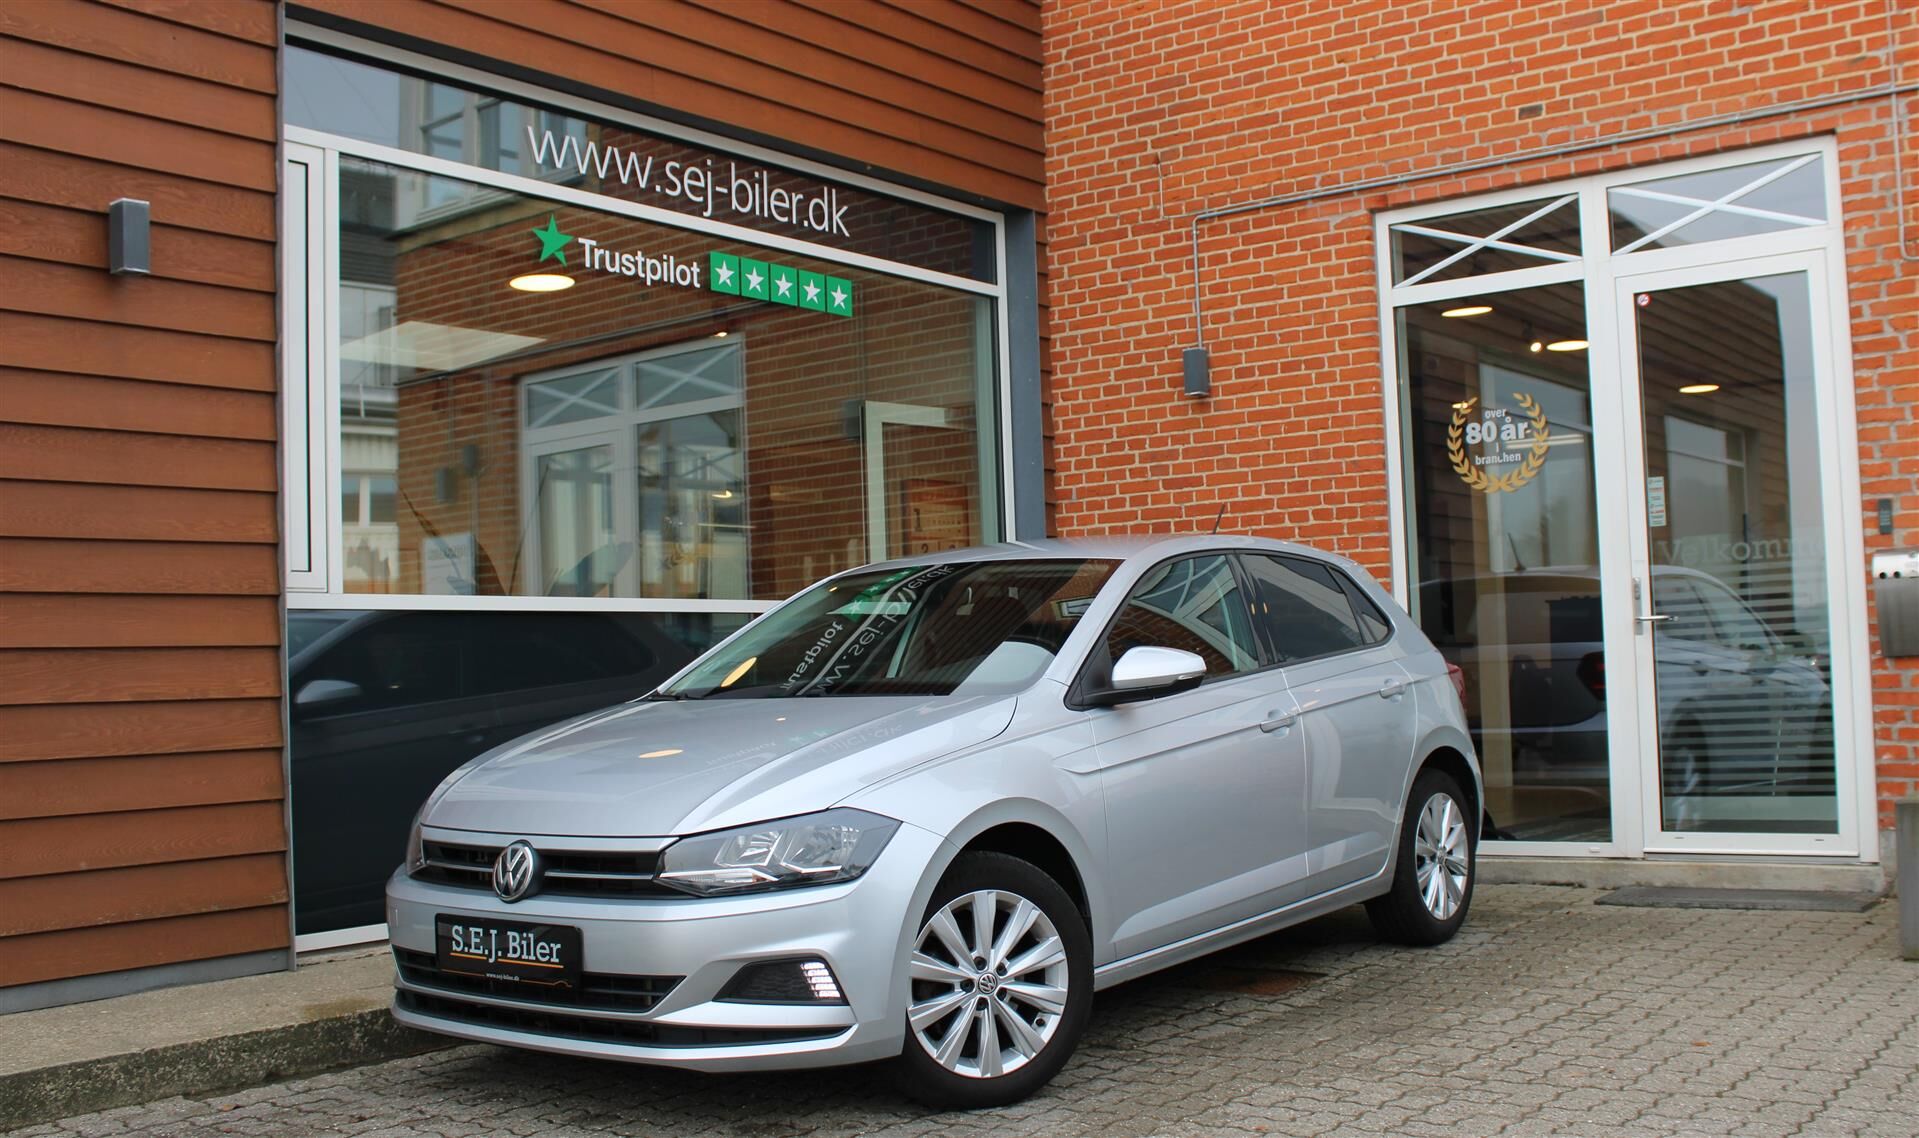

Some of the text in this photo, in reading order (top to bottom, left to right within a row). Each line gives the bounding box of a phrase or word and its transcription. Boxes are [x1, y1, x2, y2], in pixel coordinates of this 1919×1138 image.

[527, 124, 851, 238] www.sej-biler.dk
[577, 237, 701, 289] Trustpilot
[1484, 408, 1507, 419] over
[1465, 416, 1529, 445] 80 år
[1475, 452, 1521, 465] branchen
[507, 931, 561, 962] Biler
